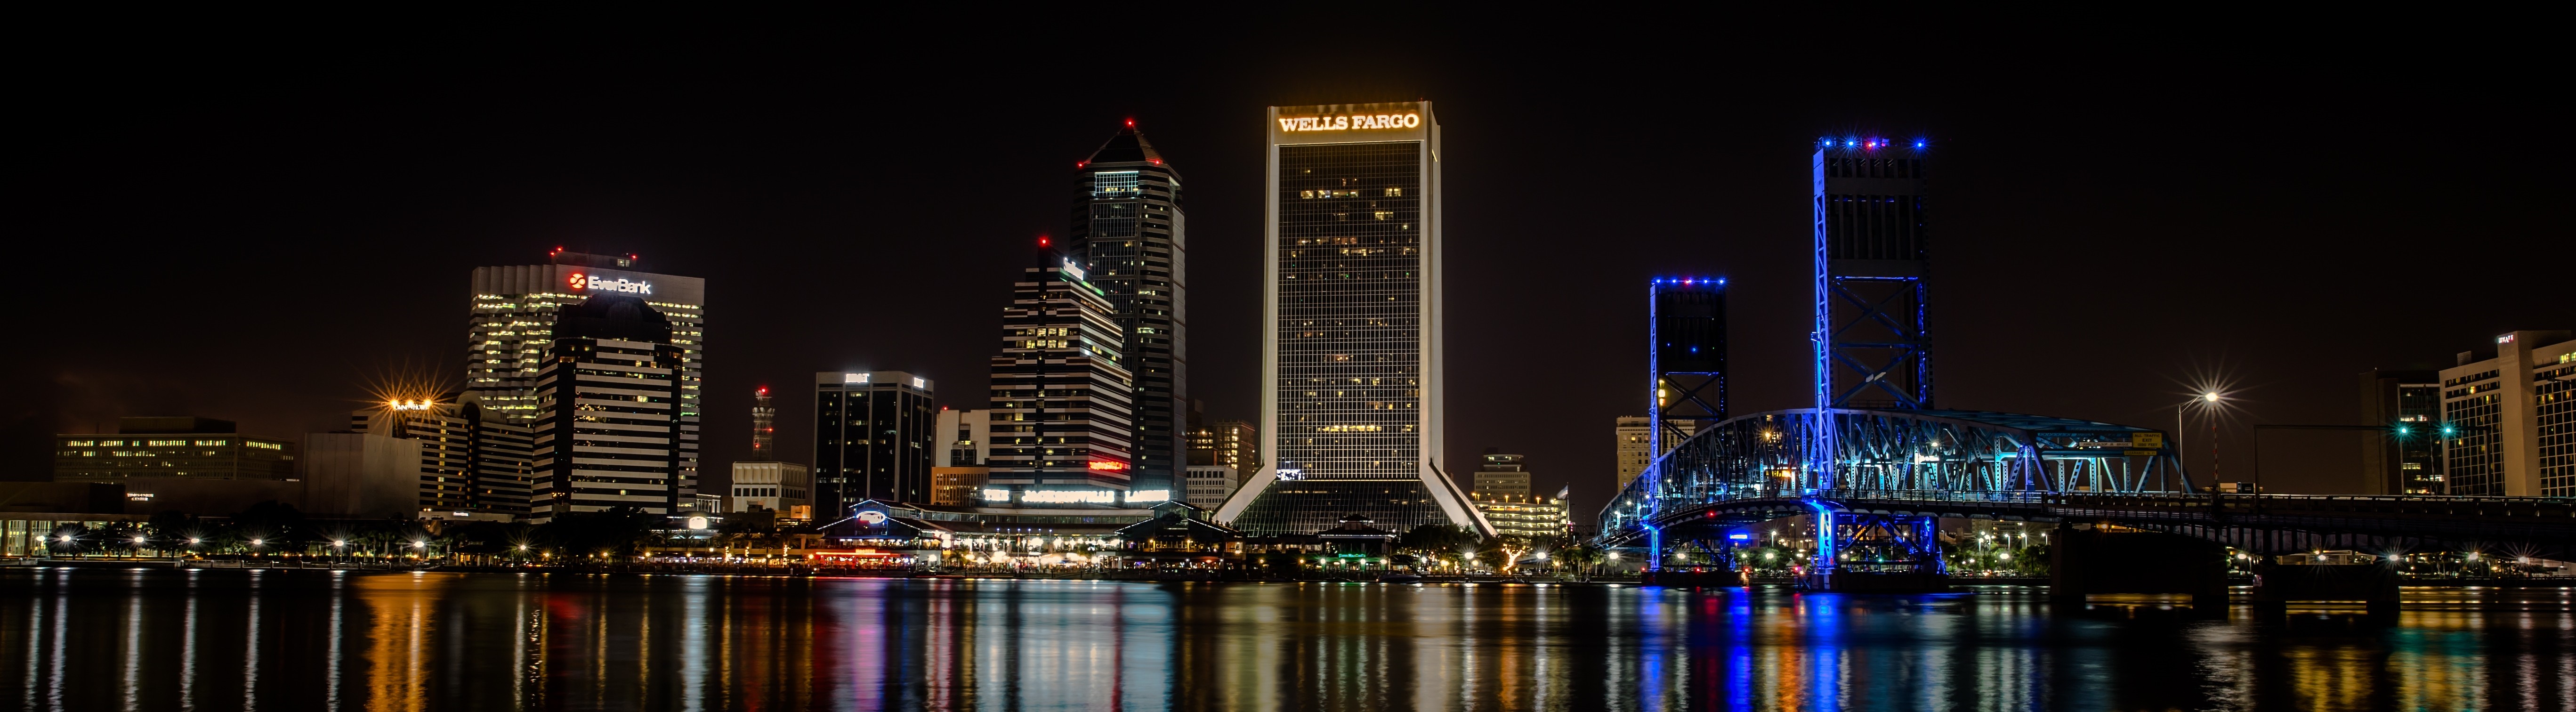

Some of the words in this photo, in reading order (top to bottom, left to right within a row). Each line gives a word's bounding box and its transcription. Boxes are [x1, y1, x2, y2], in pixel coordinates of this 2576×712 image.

[1278, 116, 1349, 132] WELLS
[1351, 113, 1420, 129] FARGO
[588, 276, 651, 294] EverBank
